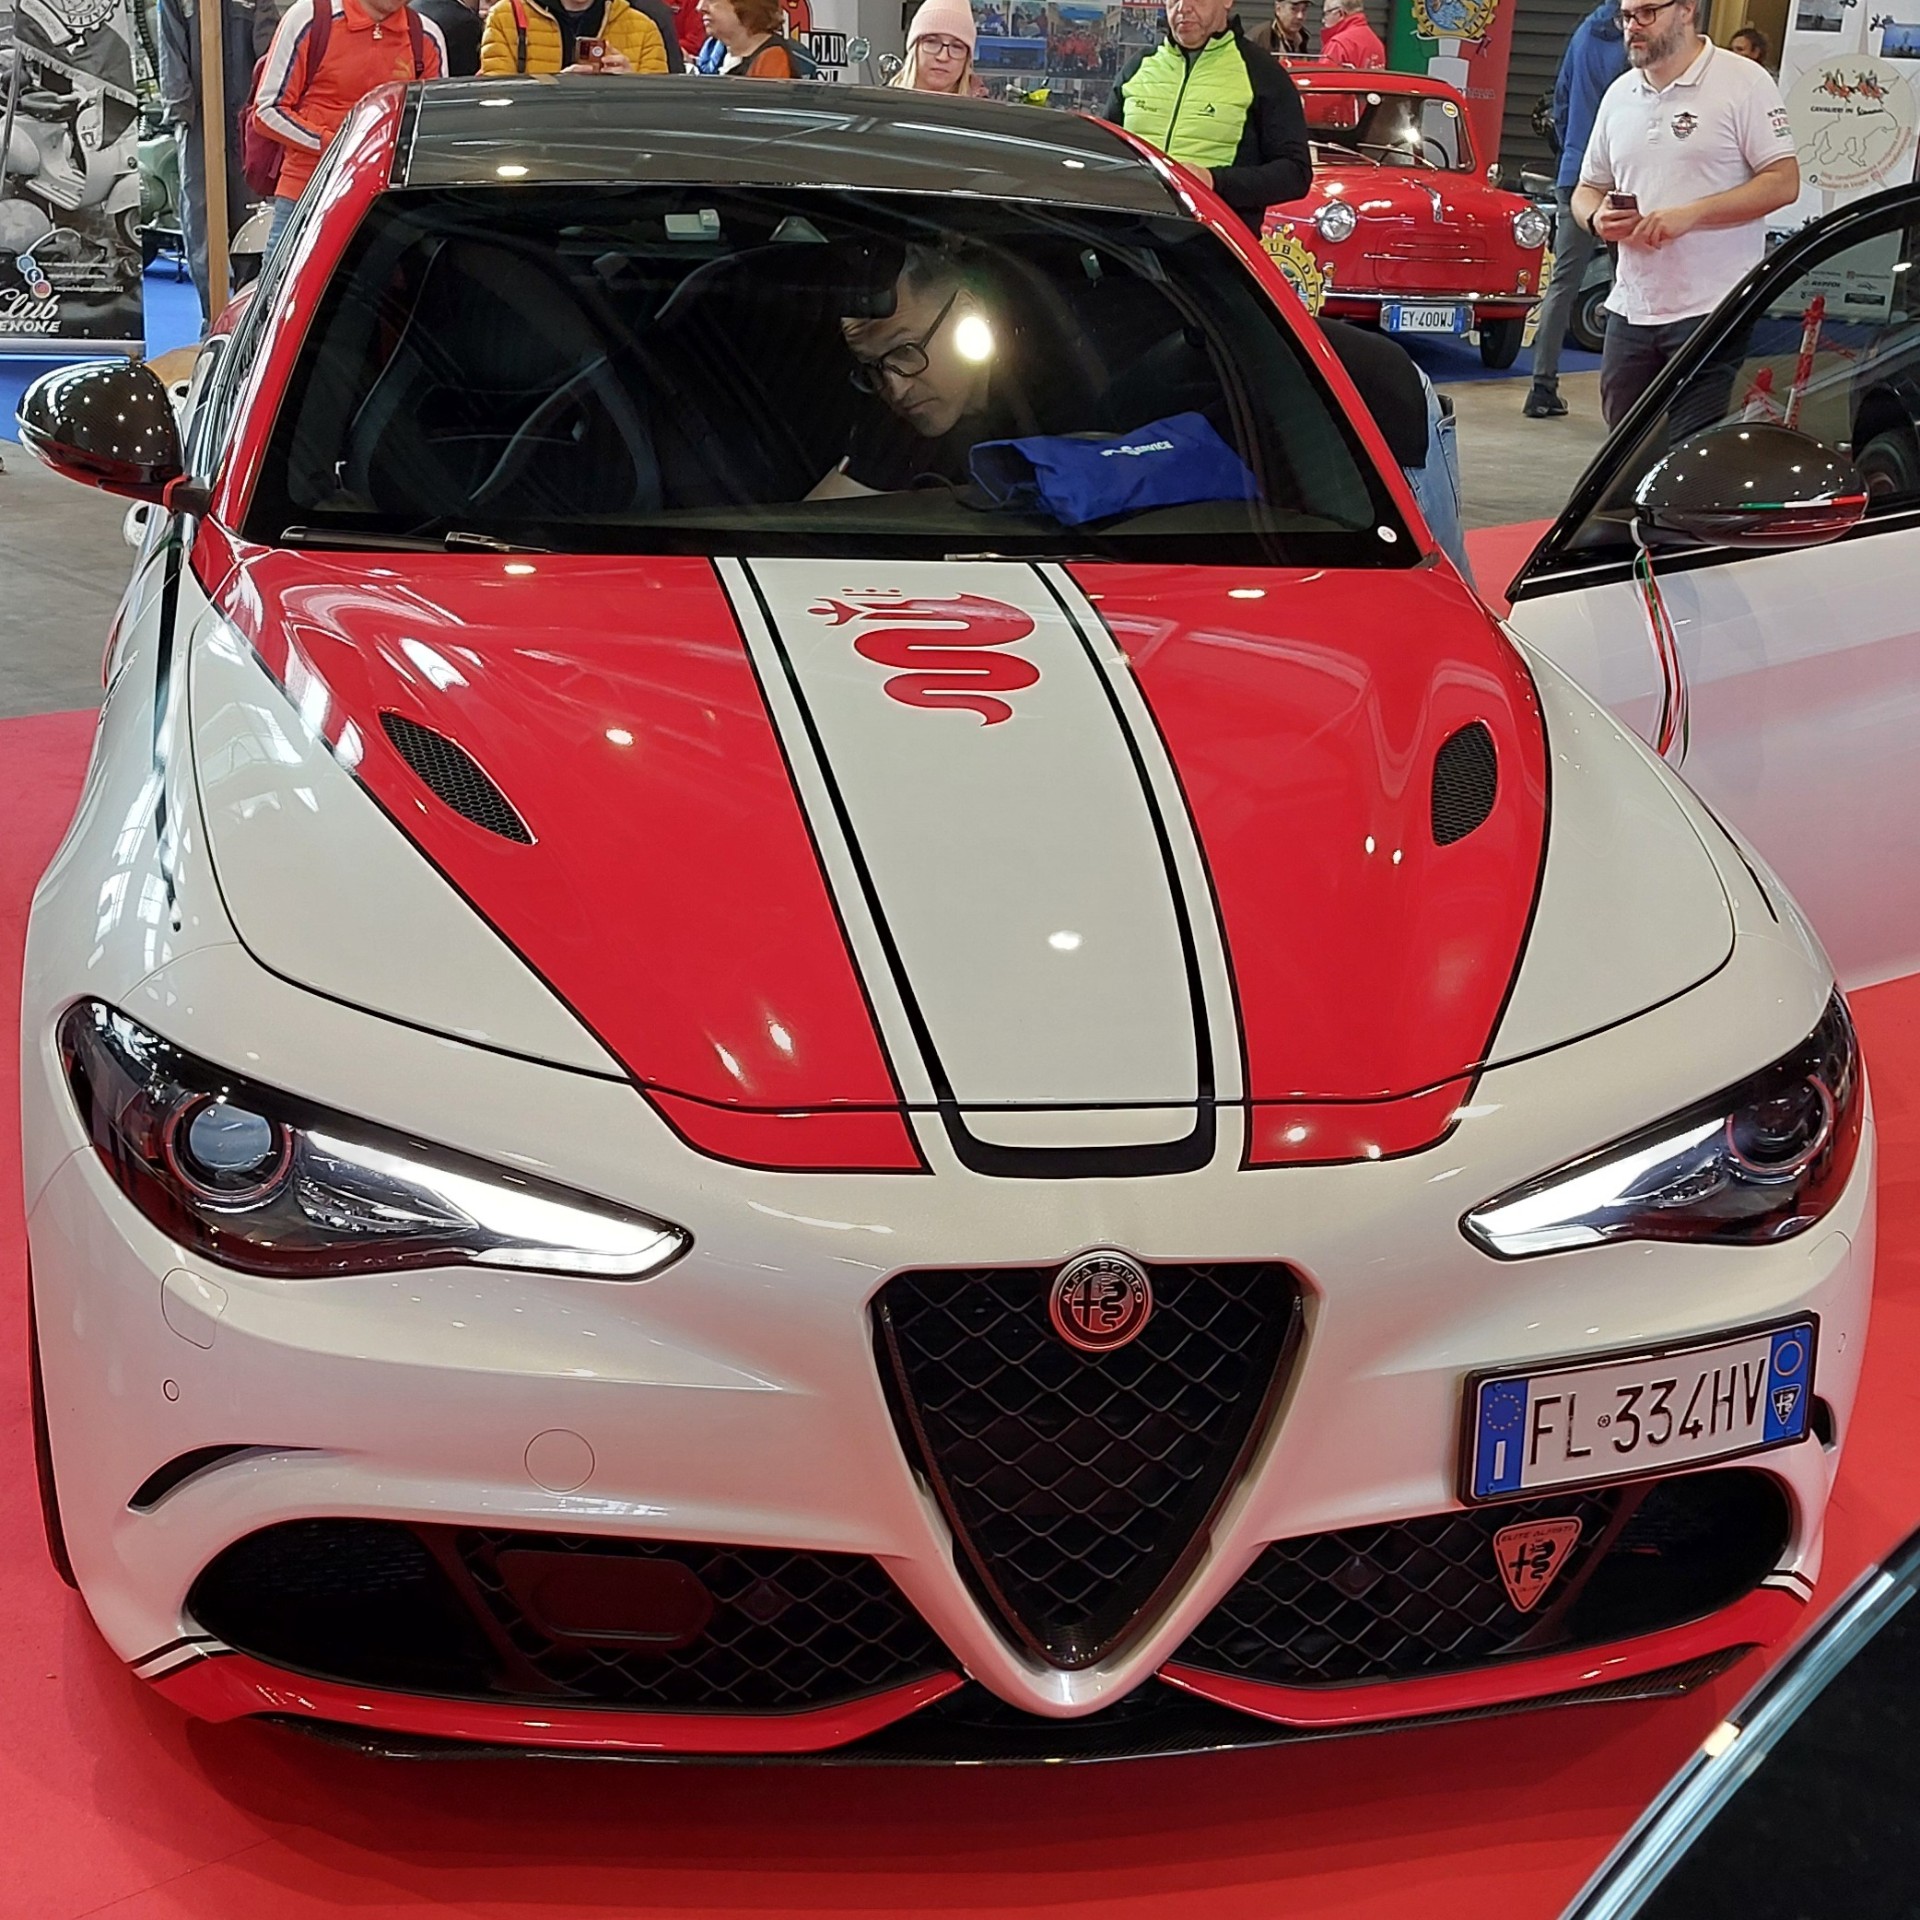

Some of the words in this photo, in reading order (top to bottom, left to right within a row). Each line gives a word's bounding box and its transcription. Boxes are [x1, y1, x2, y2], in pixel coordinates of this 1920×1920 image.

[811, 34, 846, 63] CLUB
[1062, 1268, 1092, 1305] ALFA
[1099, 1261, 1144, 1304] ROMEO
